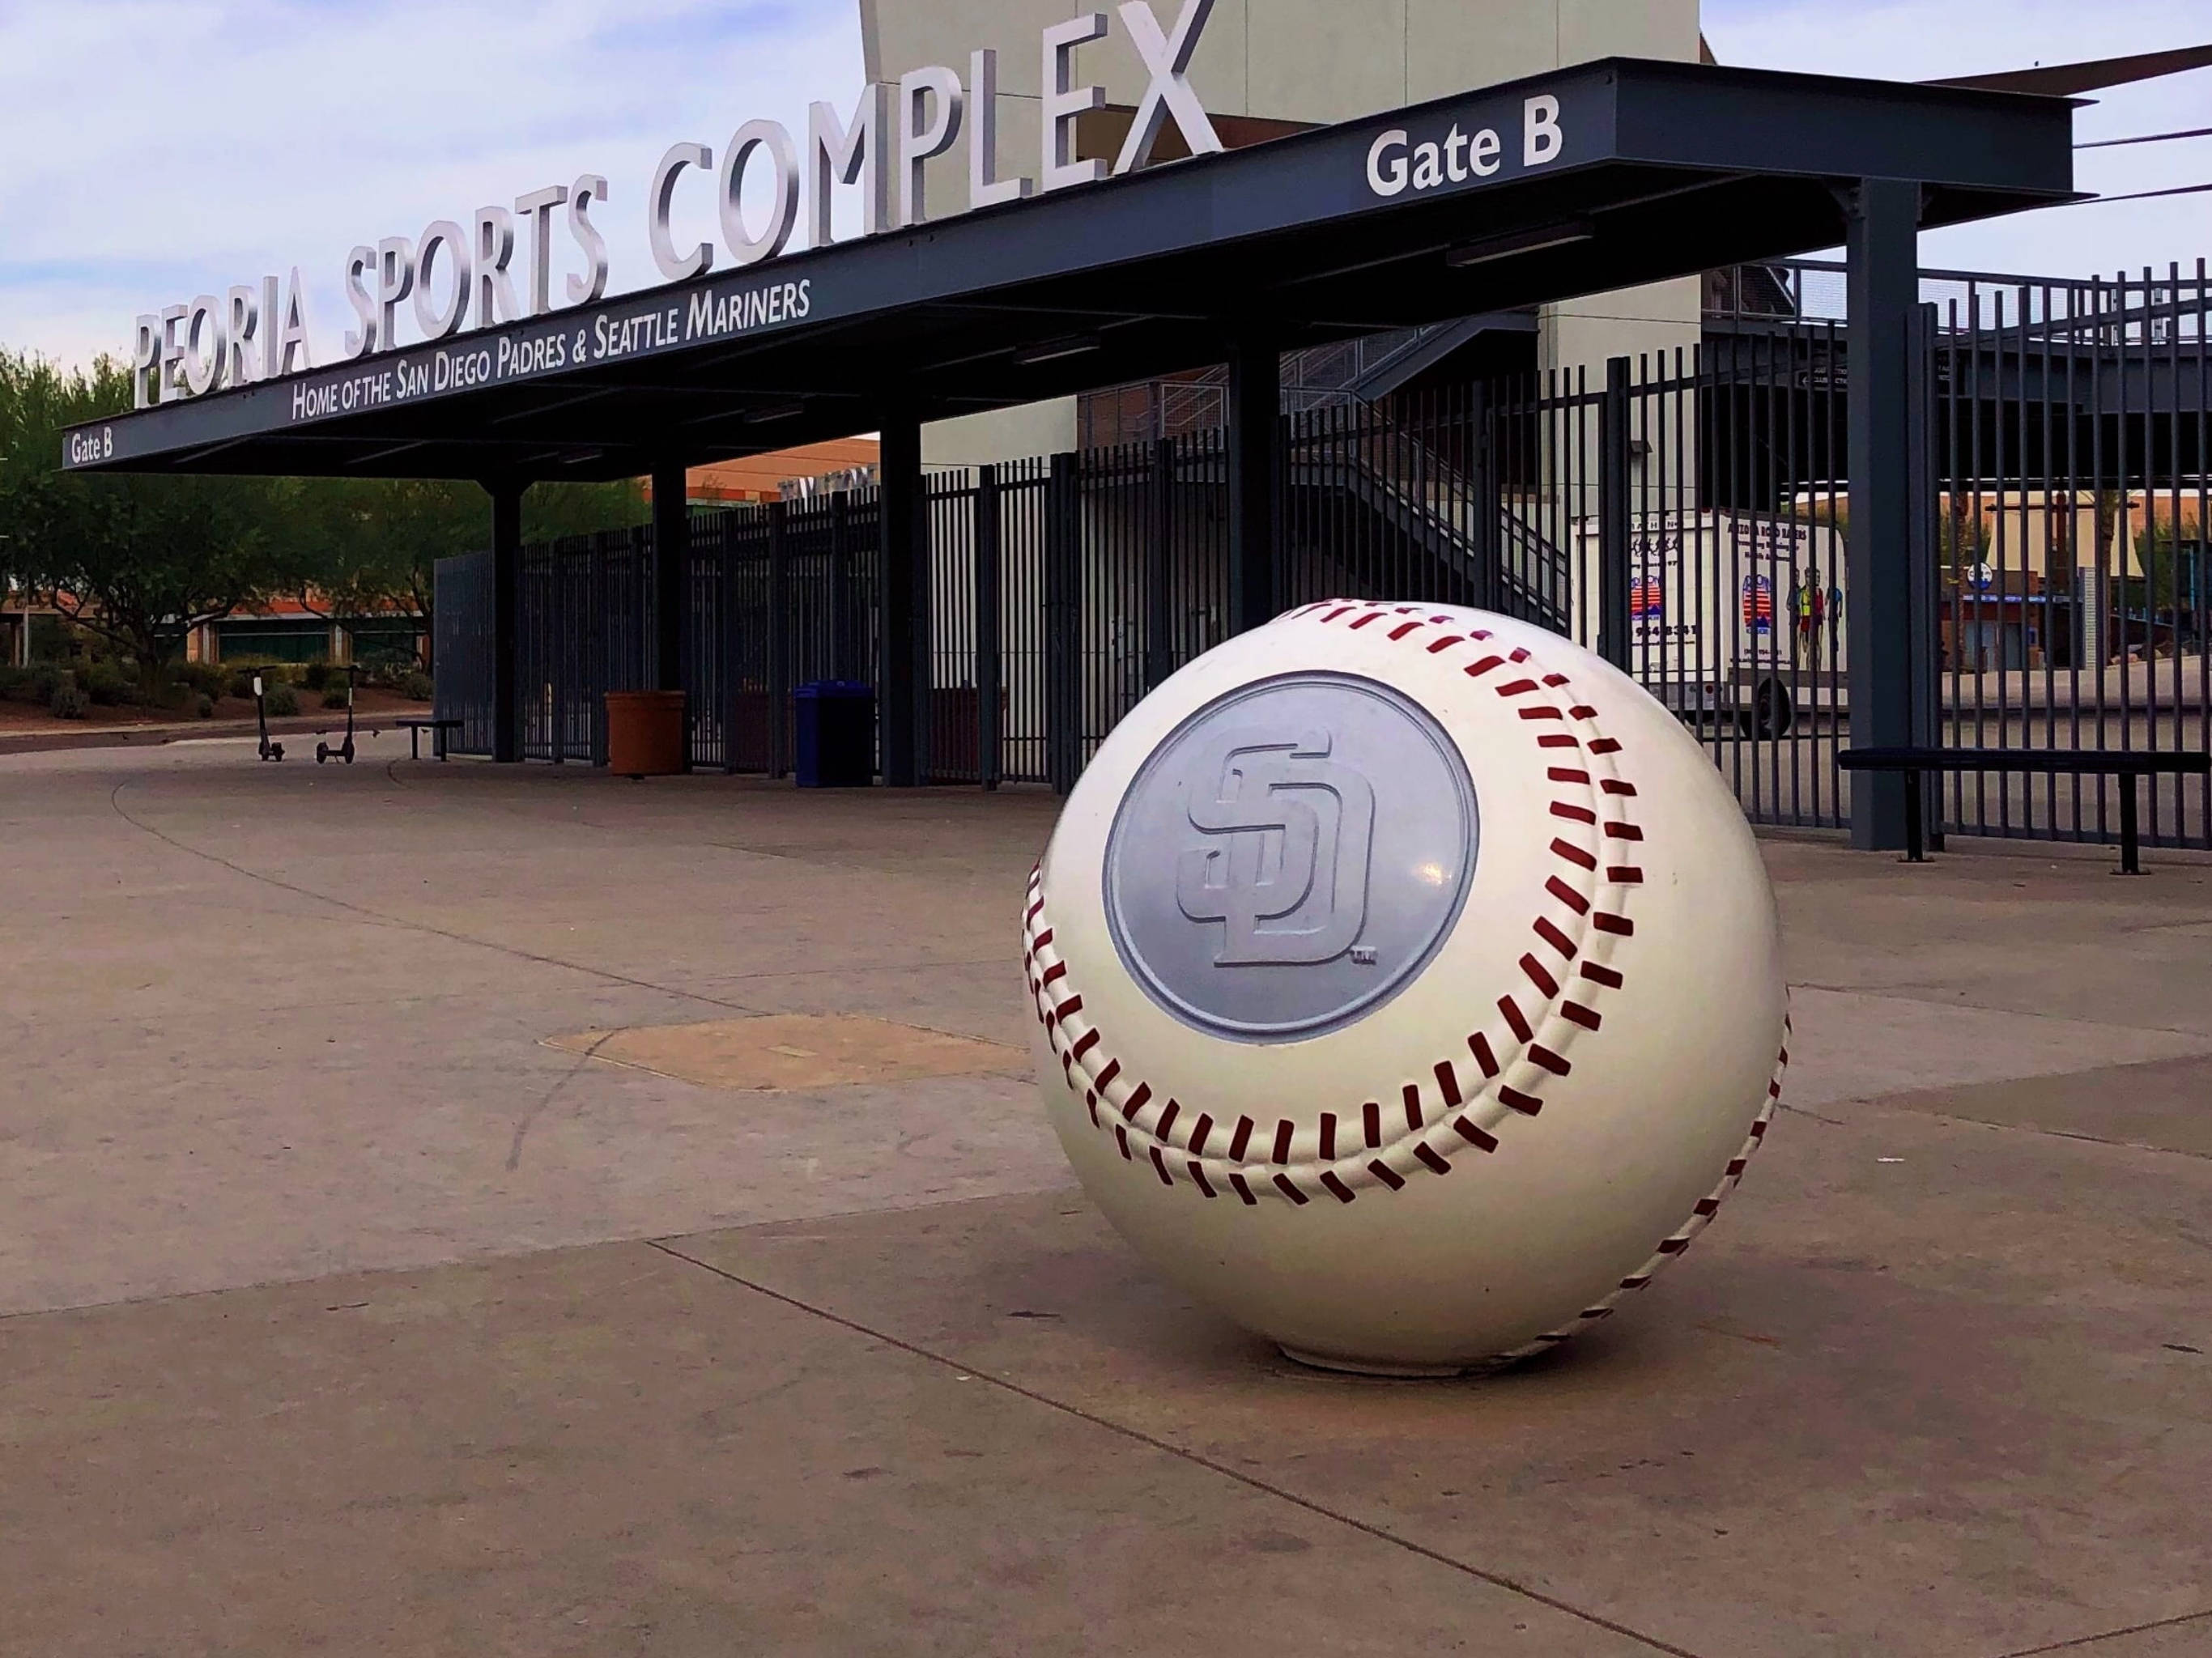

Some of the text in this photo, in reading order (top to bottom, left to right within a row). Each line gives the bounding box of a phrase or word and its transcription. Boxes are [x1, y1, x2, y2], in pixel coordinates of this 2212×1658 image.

[1367, 94, 1563, 196] Gate B
[134, 0, 1223, 409] PEORIA SPORTS COMPLEX
[572, 329, 586, 363] &
[71, 426, 113, 464] Gate B
